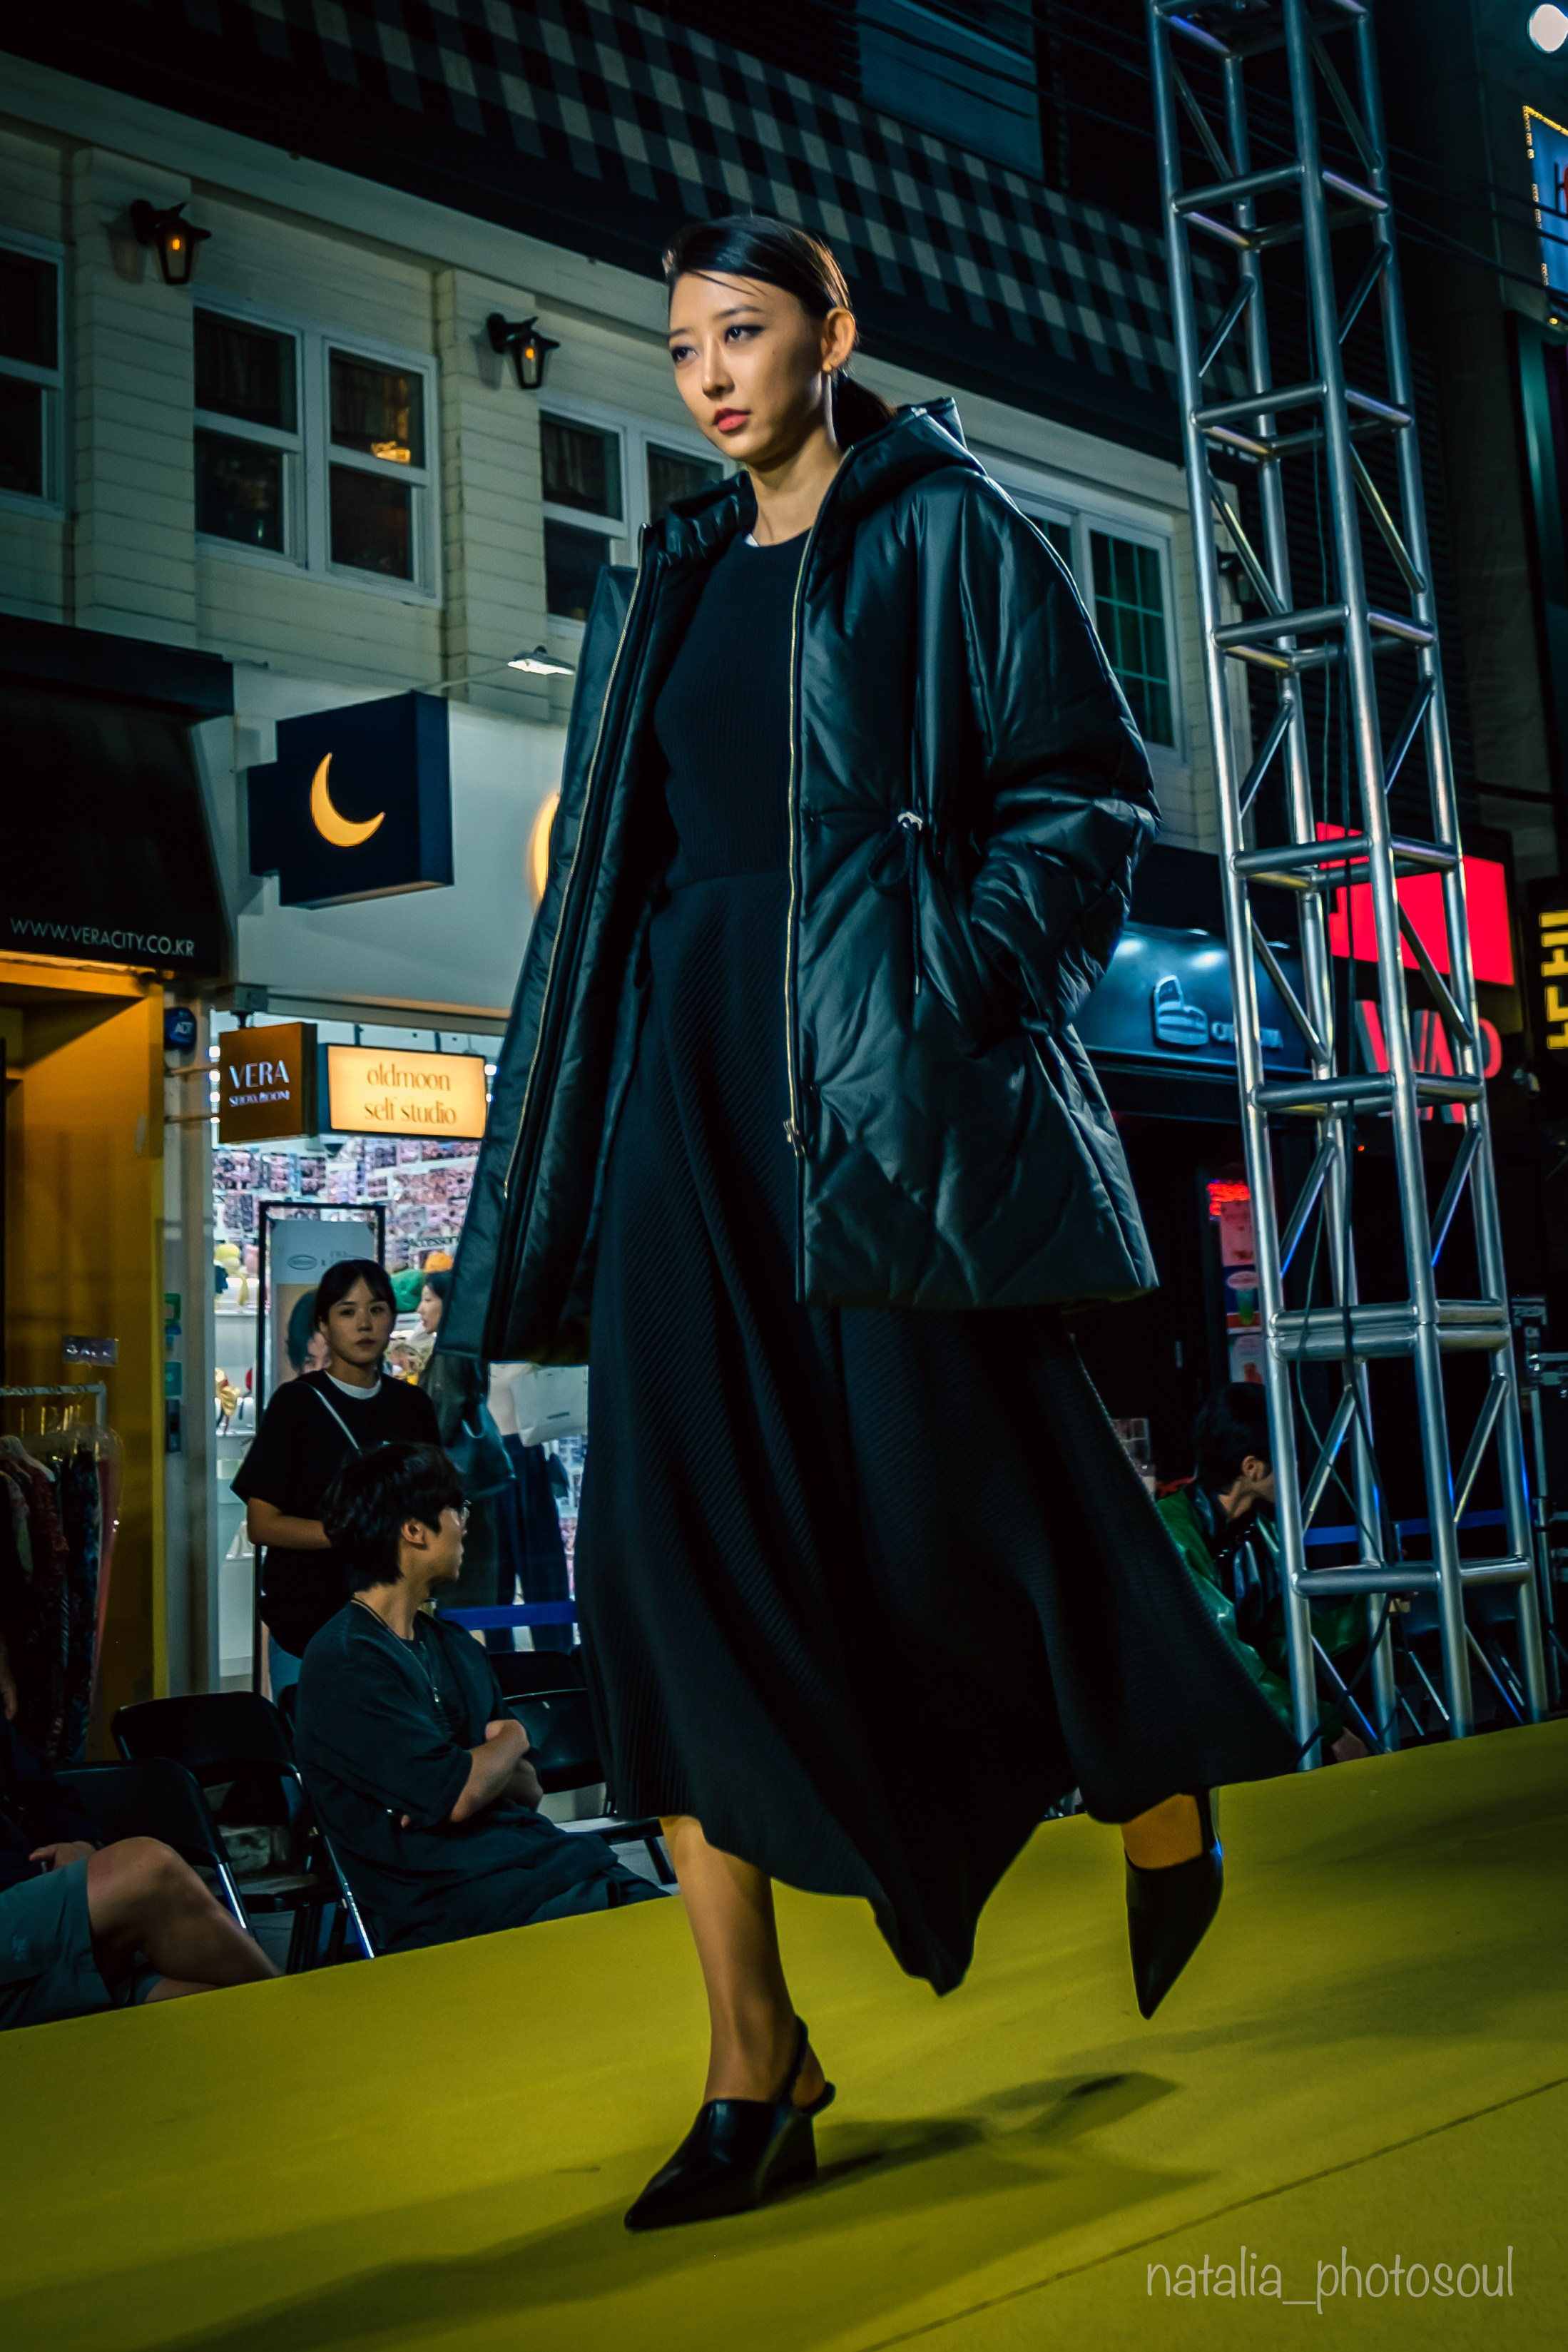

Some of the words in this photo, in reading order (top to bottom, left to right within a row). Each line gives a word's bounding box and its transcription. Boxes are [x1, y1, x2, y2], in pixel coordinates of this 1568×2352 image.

[10, 917, 195, 957] WWW.VERACITY.CO.KR
[229, 1059, 290, 1089] VERA
[367, 1062, 451, 1091] oldmoon
[400, 1100, 457, 1126] studio
